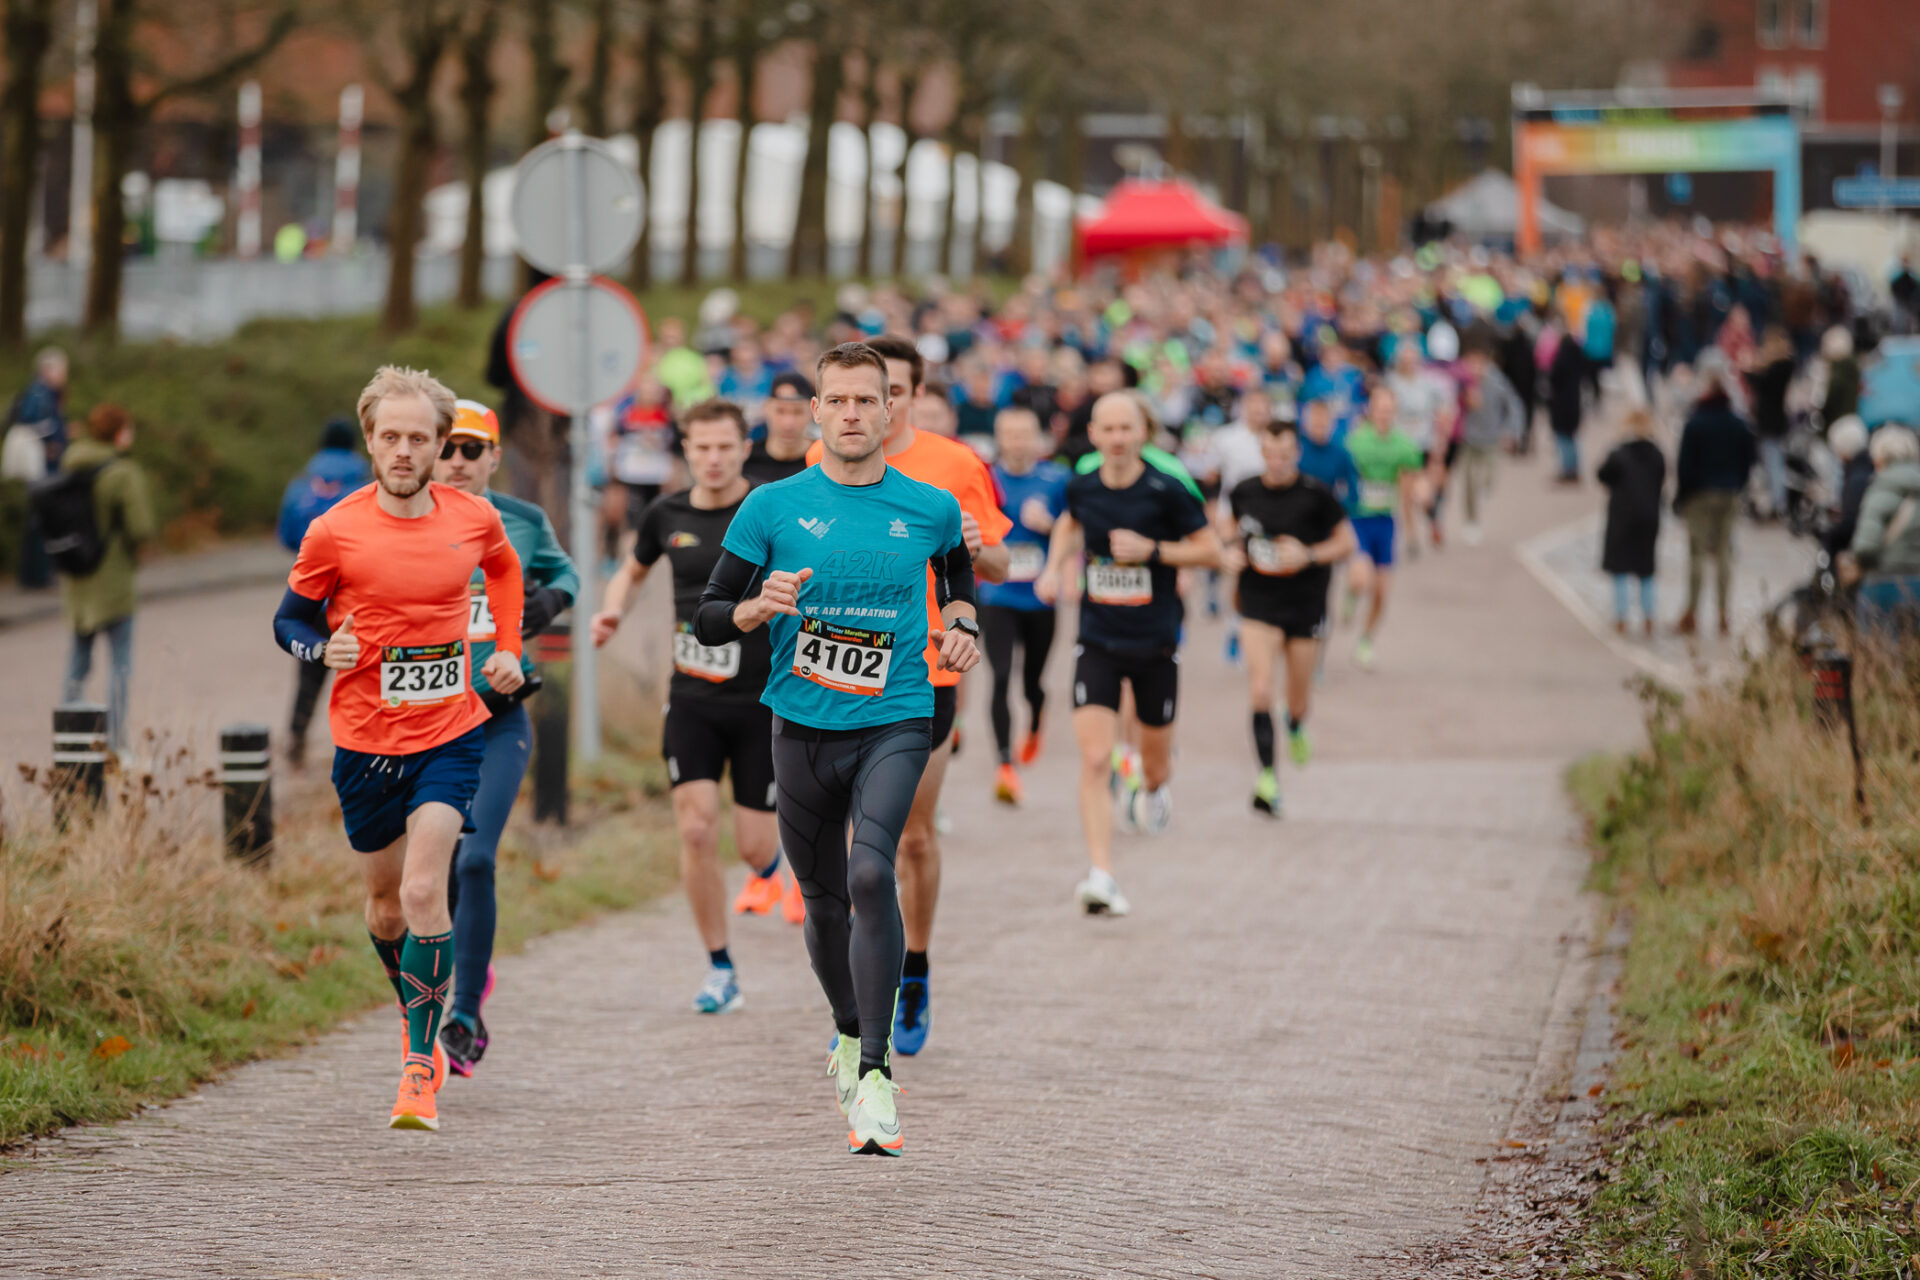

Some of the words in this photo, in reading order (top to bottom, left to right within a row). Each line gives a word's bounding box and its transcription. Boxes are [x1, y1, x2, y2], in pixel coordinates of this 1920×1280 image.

[820, 550, 900, 580] 42K
[805, 606, 819, 615] WE
[822, 607, 842, 616] ARE
[844, 607, 898, 618] MARATHON
[802, 638, 884, 679] 4102
[388, 660, 459, 692] 2328
